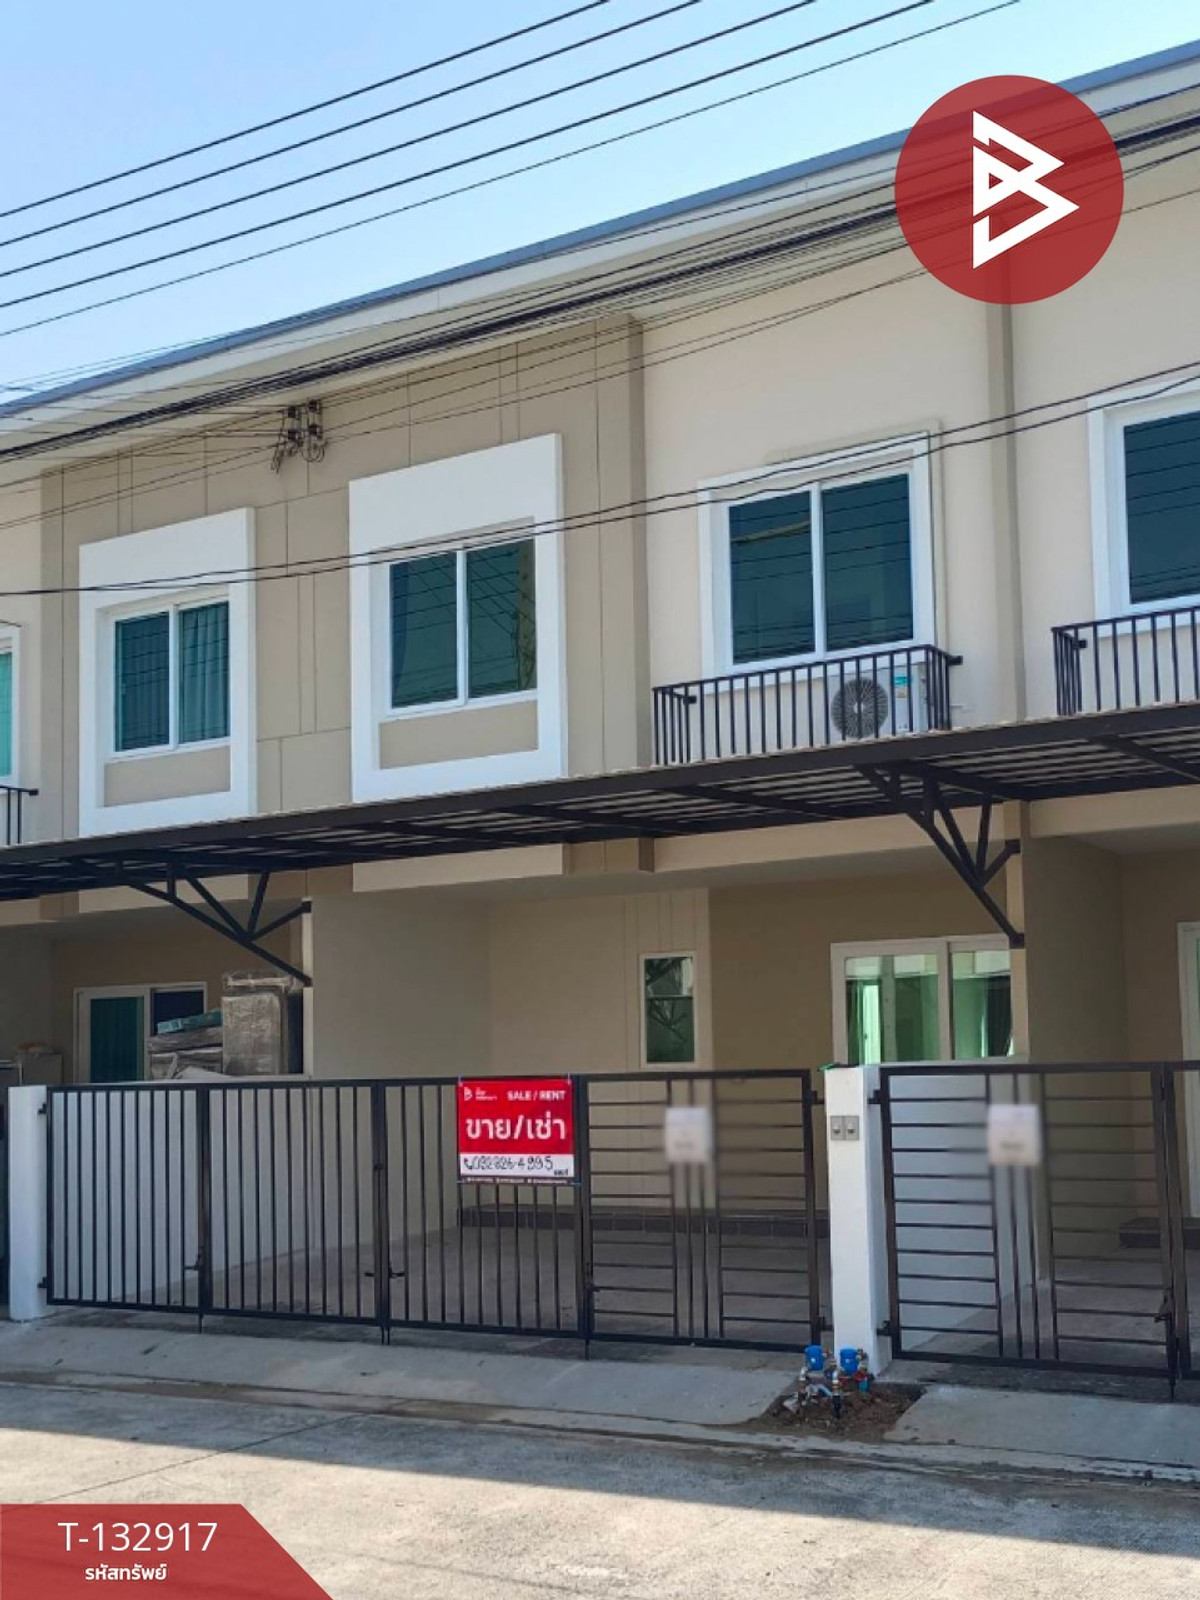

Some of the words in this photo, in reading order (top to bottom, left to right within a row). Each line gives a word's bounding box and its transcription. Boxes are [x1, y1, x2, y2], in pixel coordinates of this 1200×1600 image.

[507, 1090, 531, 1101] SALE
[539, 1090, 566, 1100] RENT
[466, 1111, 566, 1140] ขาย/เช่า
